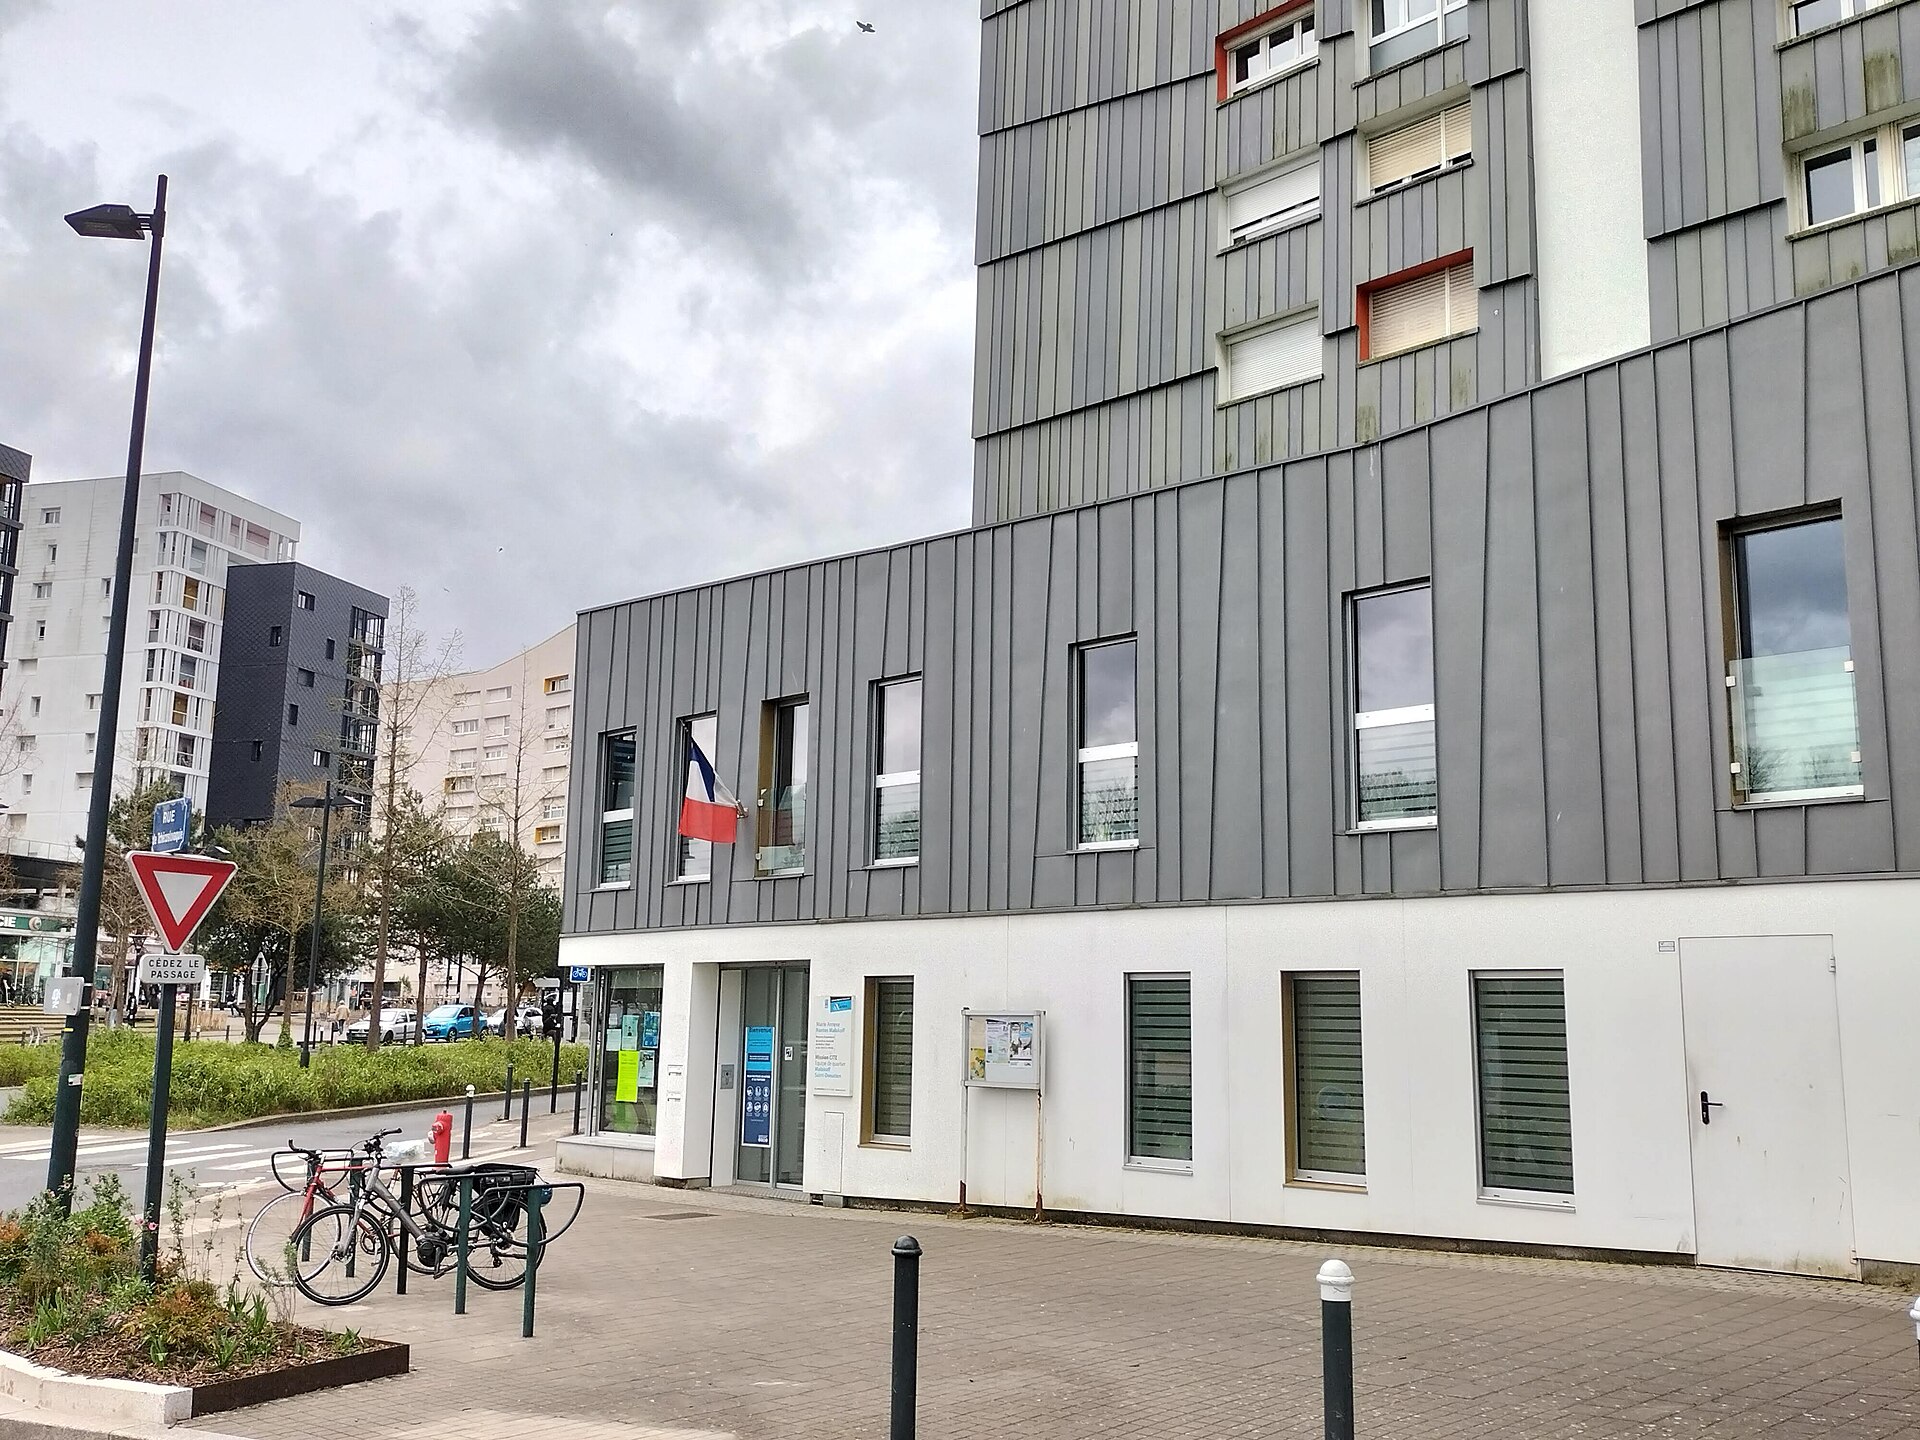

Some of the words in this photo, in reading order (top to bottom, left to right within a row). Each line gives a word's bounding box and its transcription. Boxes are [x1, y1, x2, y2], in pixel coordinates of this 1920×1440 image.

[162, 810, 176, 824] RUE
[148, 957, 182, 968] CÉDEZ
[189, 959, 200, 968] LE
[150, 970, 196, 979] PASSAGE
